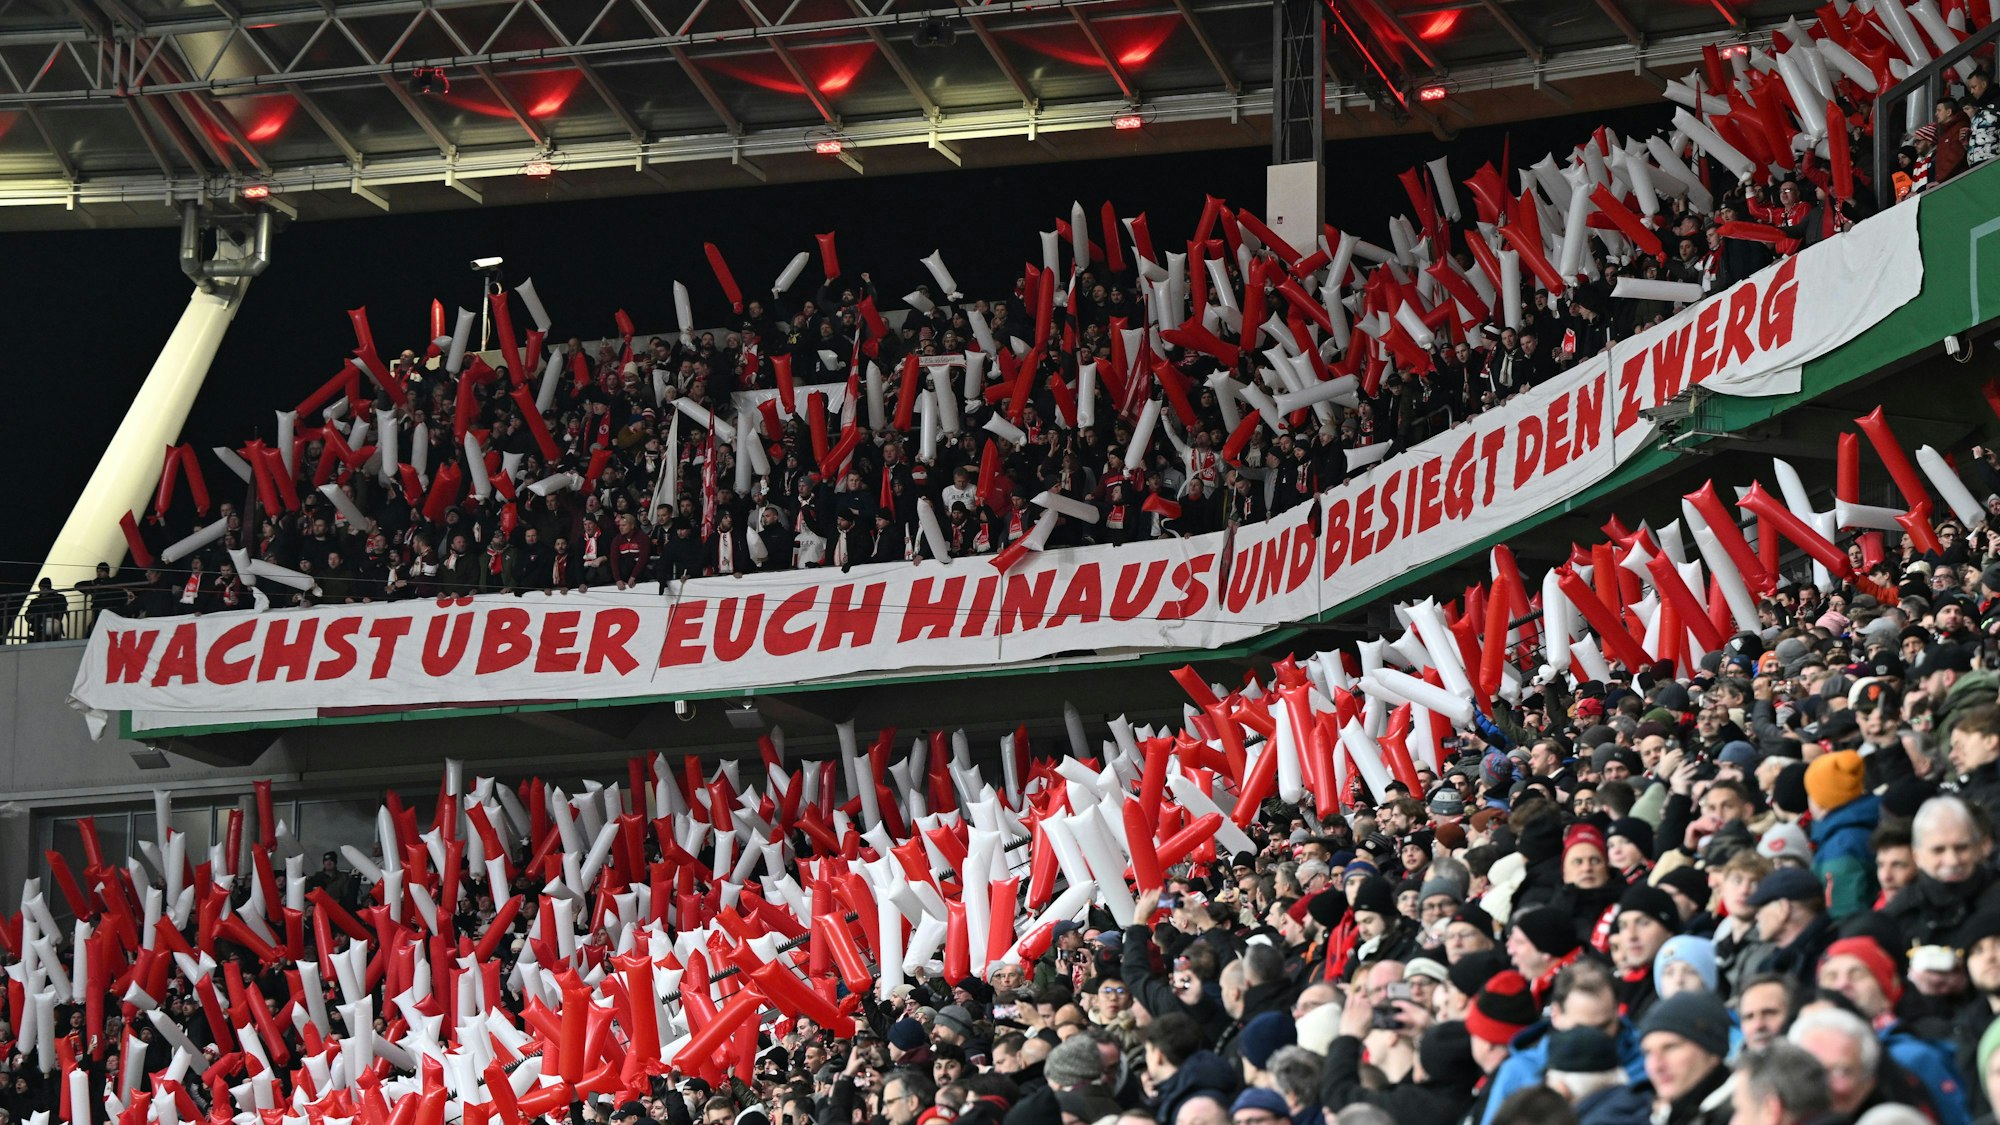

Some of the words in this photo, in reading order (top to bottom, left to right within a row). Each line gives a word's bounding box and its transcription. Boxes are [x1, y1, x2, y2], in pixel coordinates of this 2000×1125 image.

[106, 616, 413, 687] WACHST
[422, 596, 641, 677] ÜBER
[659, 583, 887, 669] EUCH
[898, 553, 1215, 643] HINAUS
[1227, 521, 1317, 614] UND
[1323, 427, 1506, 580] BESIEGT
[1513, 373, 1606, 490] DEN
[1613, 255, 1799, 437] ZWERG
